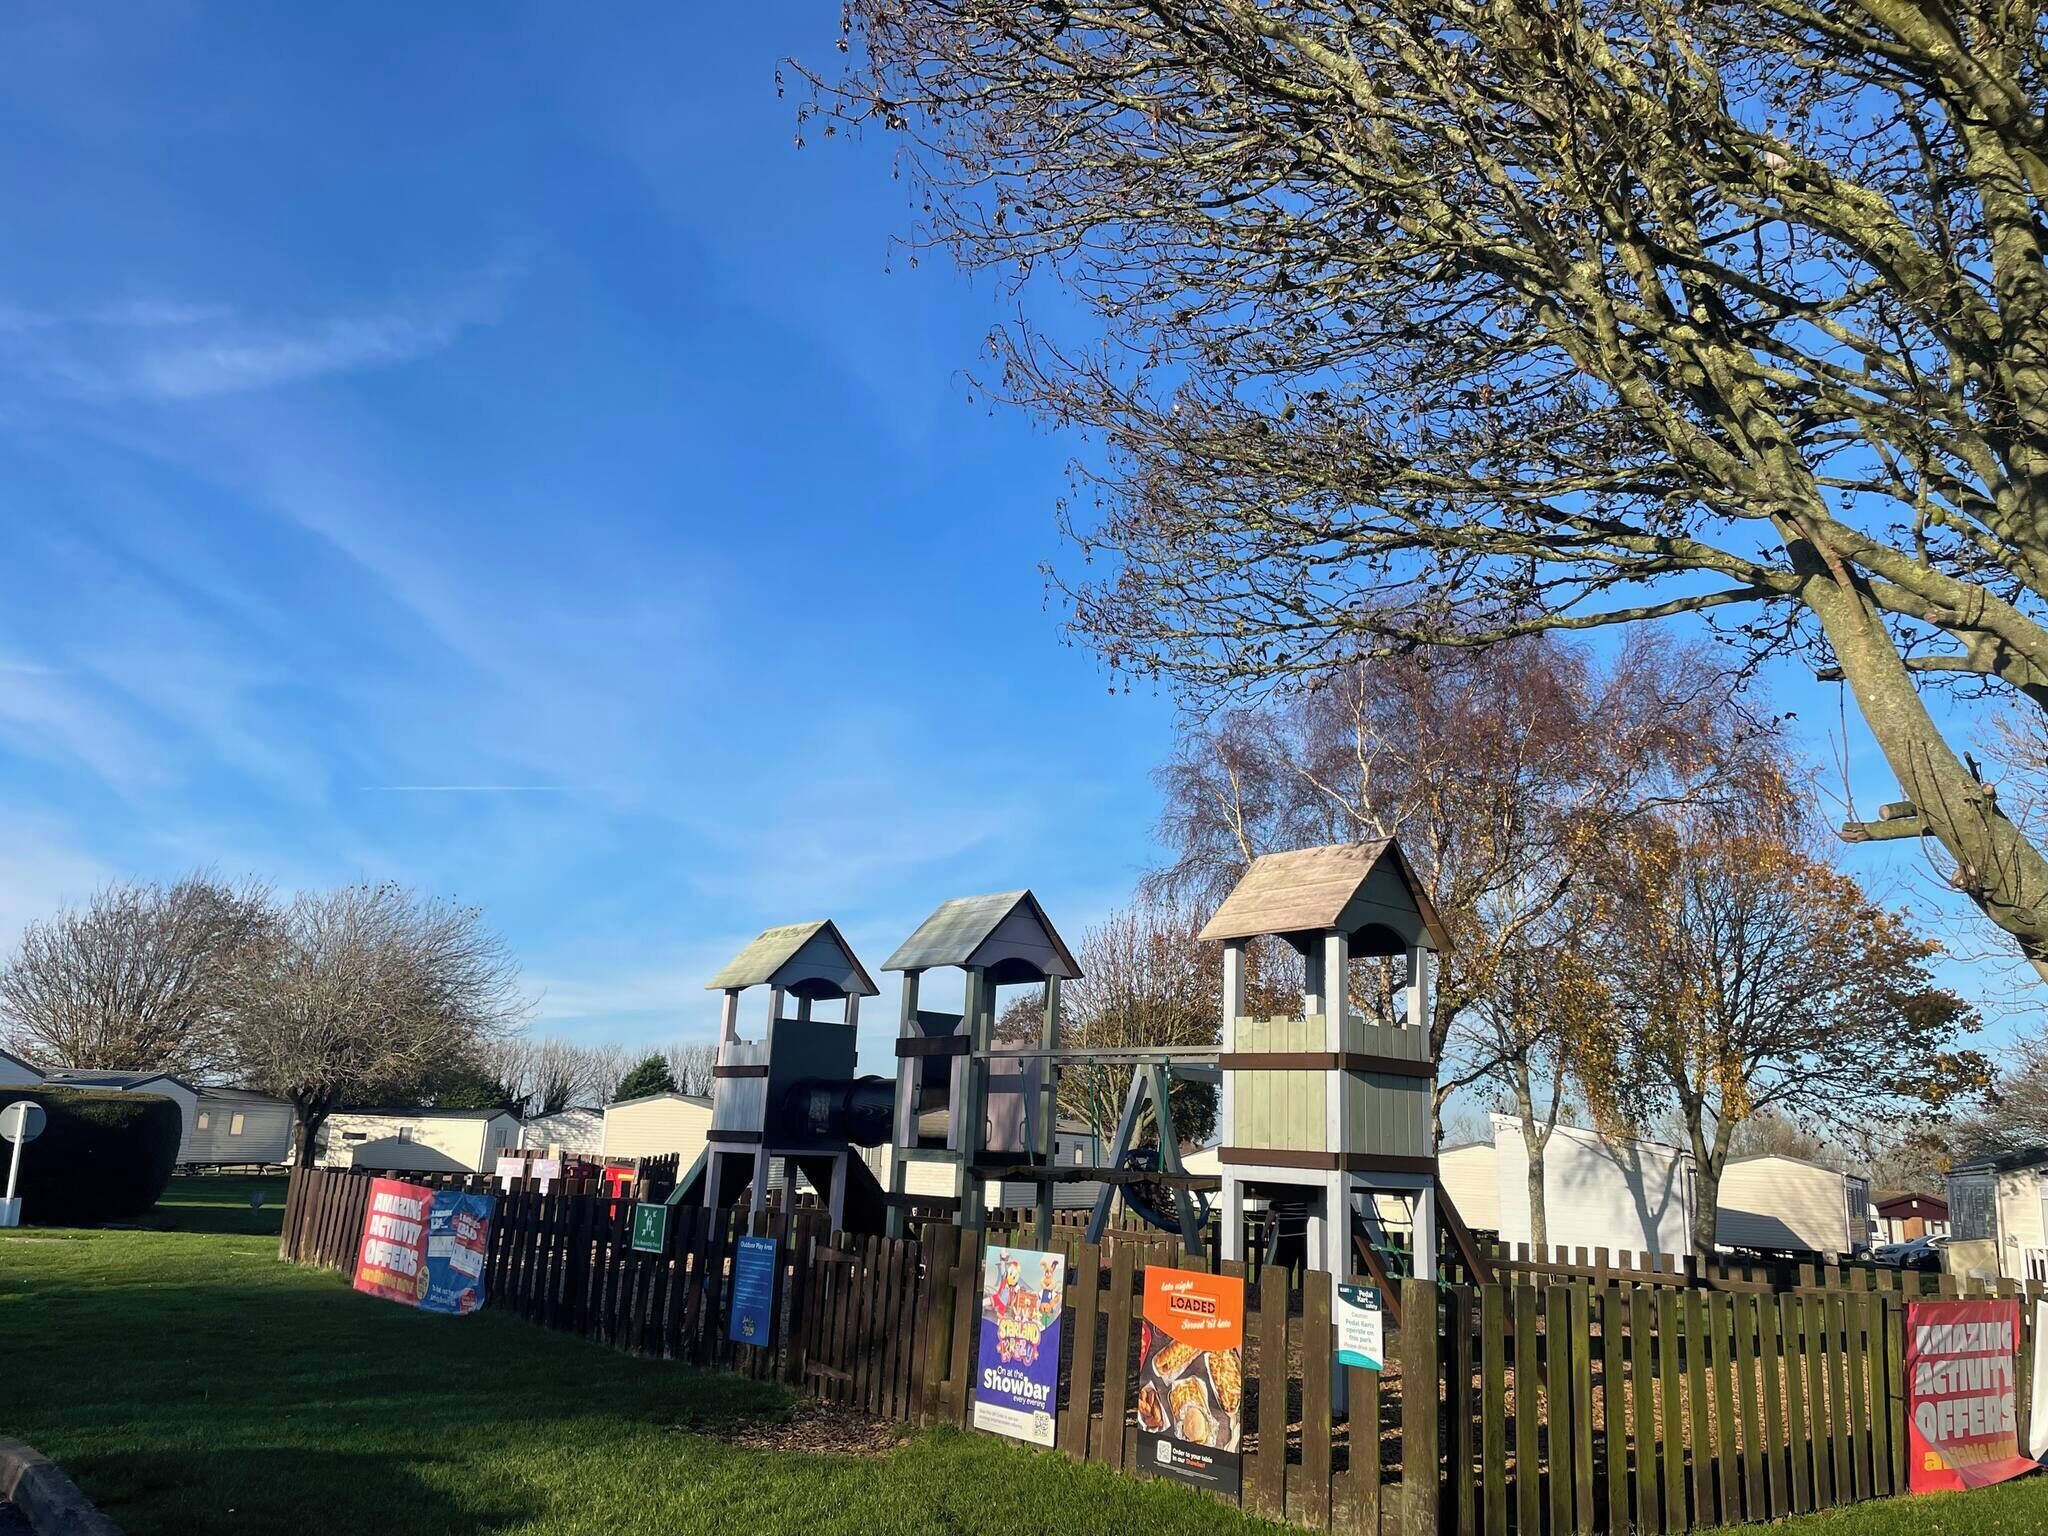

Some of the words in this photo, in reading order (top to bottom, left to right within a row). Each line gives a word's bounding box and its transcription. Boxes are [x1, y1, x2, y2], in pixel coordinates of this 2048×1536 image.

[369, 1214, 422, 1246] ACTIVITY
[756, 1242, 764, 1252] Play
[764, 1243, 773, 1251] Area
[364, 1238, 419, 1277] OFFERS
[1174, 1280, 1194, 1293] night
[1358, 1289, 1374, 1298] Pedal
[1170, 1296, 1216, 1314] LOADED
[1916, 1320, 2012, 1356] AMAZING
[997, 1366, 1006, 1376] On
[1007, 1369, 1013, 1378] at
[1014, 1369, 1024, 1380] the
[1914, 1355, 2012, 1396] ACTIVITY
[984, 1368, 1050, 1401] Showbar
[1013, 1396, 1027, 1406] every
[1026, 1398, 1046, 1410] evening
[1914, 1392, 2016, 1444] OFFERS
[1172, 1448, 1185, 1456] Order
